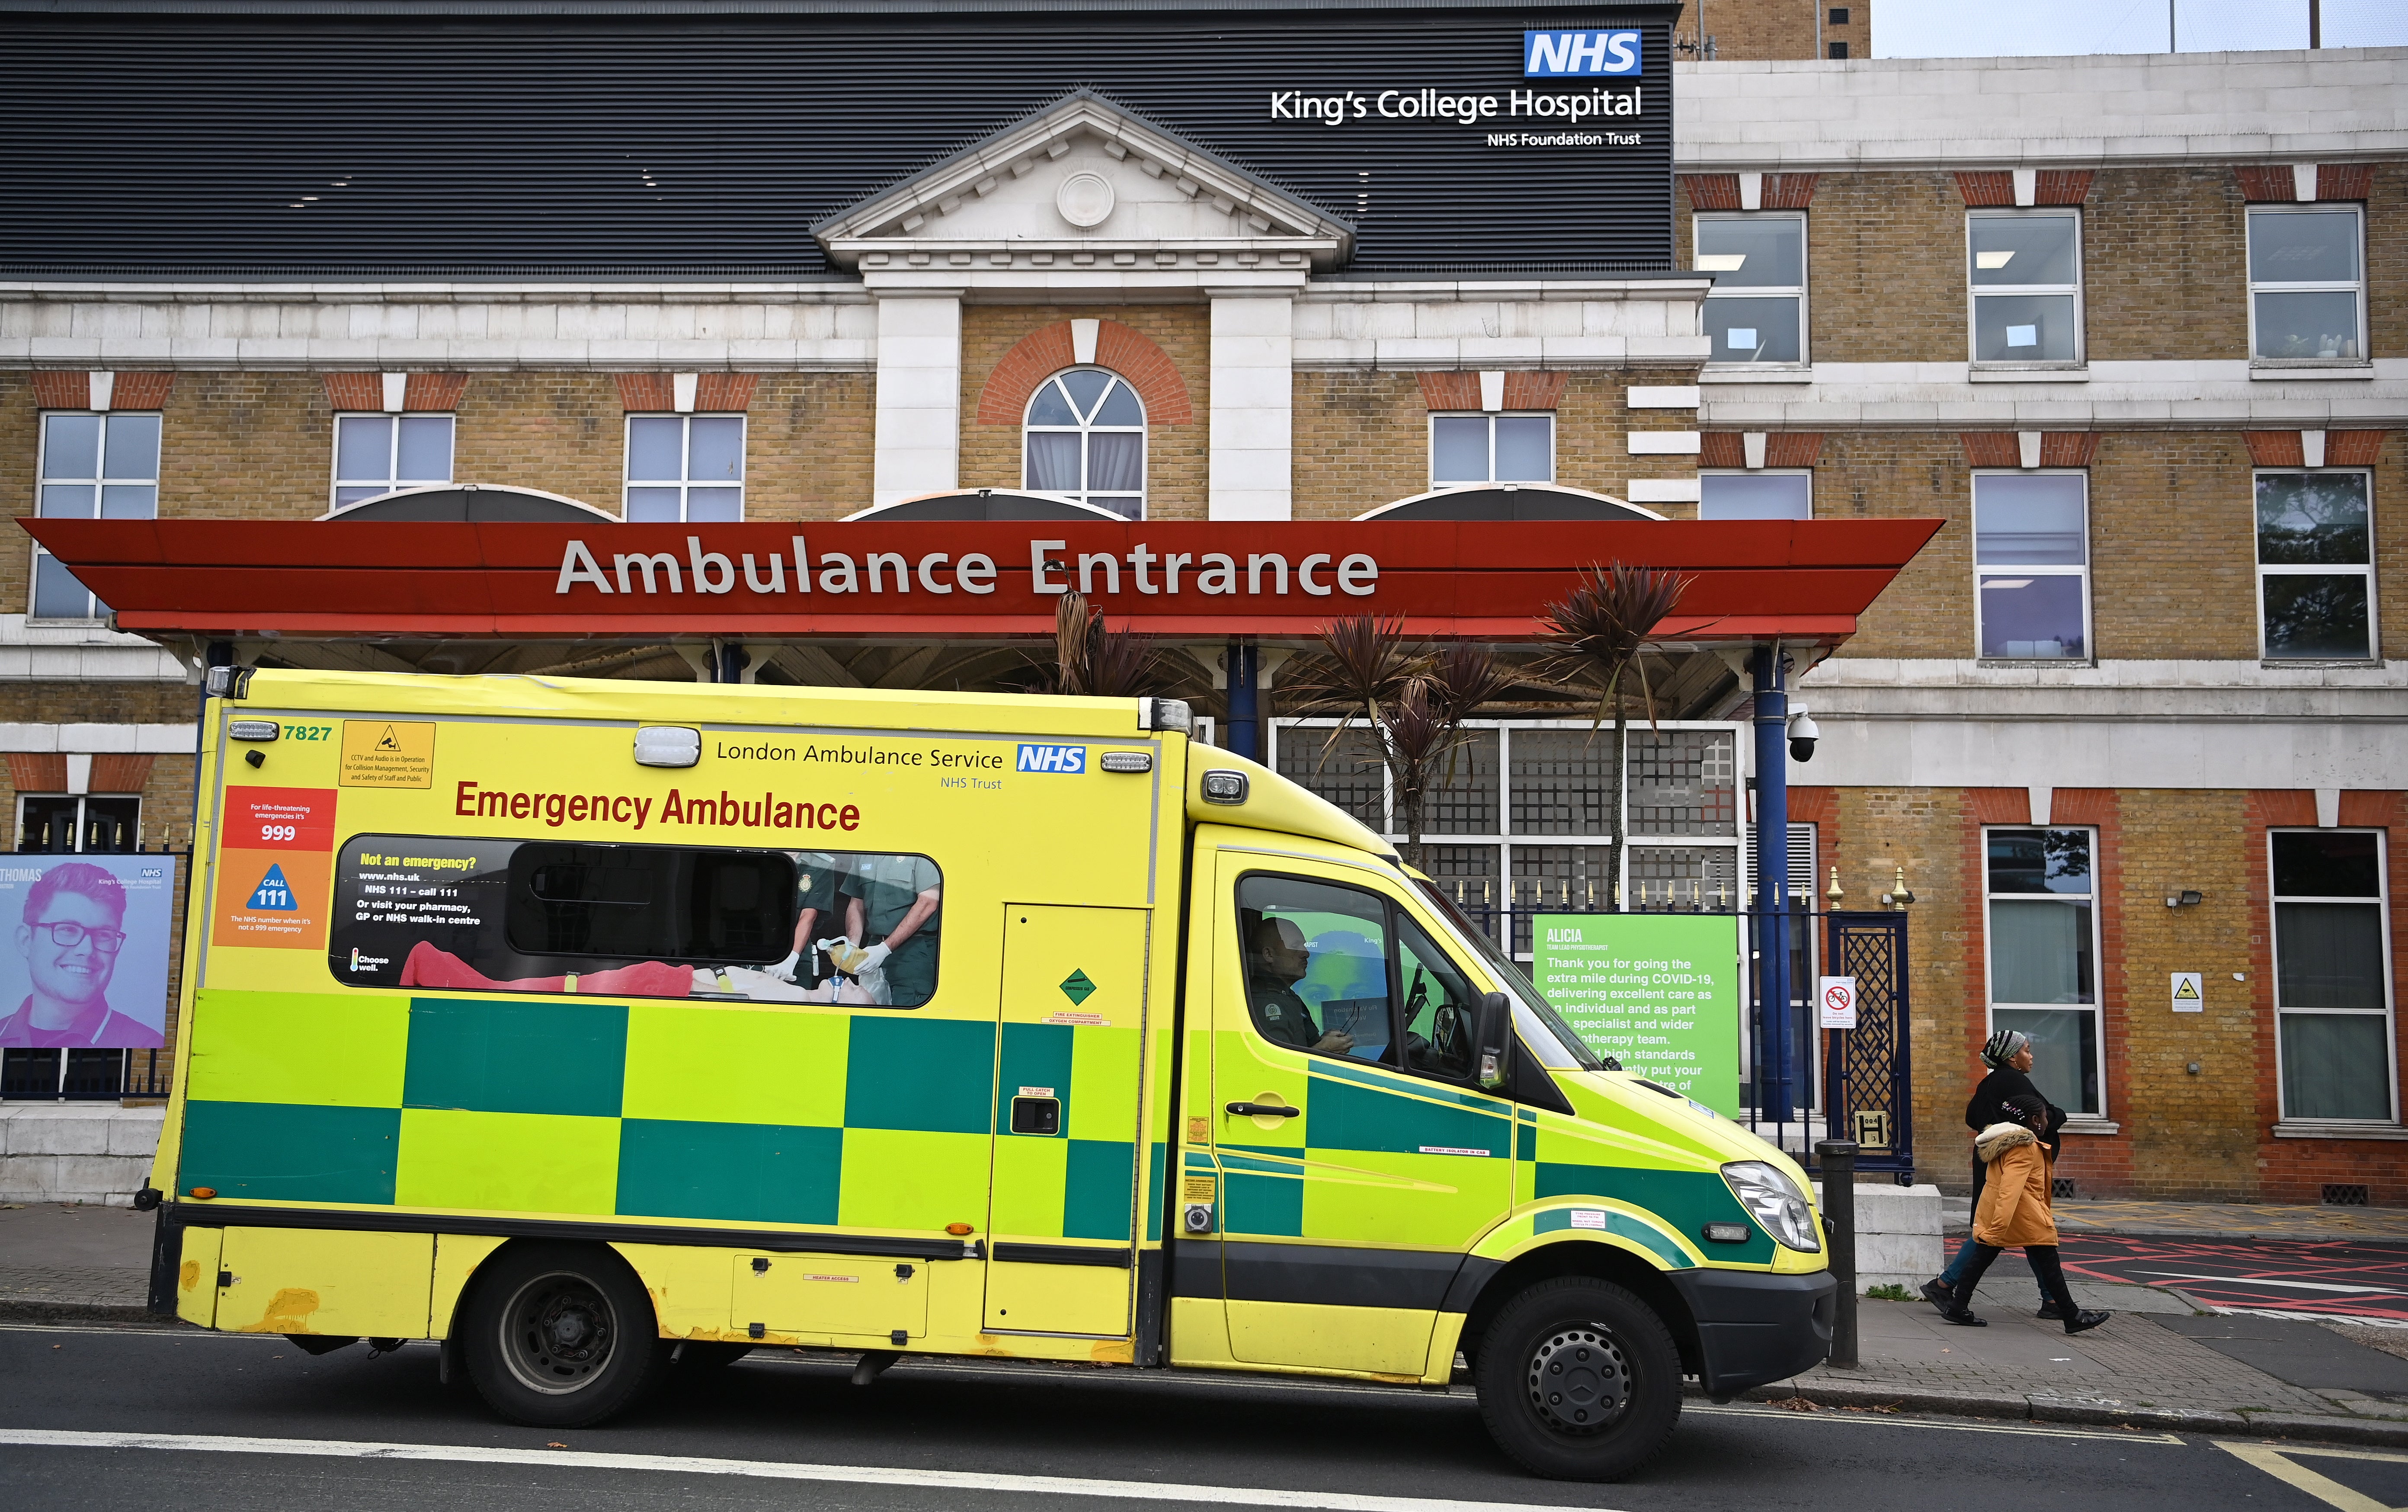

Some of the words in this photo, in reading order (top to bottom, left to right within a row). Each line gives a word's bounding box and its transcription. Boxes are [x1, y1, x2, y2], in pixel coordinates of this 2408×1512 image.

[1528, 33, 1638, 73] NHS
[1271, 91, 1366, 125] King's
[1377, 89, 1498, 124] College
[1510, 87, 1641, 122] Hospital
[1488, 134, 1517, 146] NHS
[1521, 132, 1602, 146] Foundation
[1605, 132, 1641, 145] Trust
[556, 536, 997, 594] Ambulance
[1031, 540, 1378, 596] Entrance
[284, 726, 332, 741] 7827
[717, 742, 795, 761] London
[803, 743, 922, 766] Ambulance
[930, 750, 1003, 769] Service
[1018, 746, 1084, 772] NHS
[941, 777, 967, 789] NHS
[971, 778, 1002, 790] Trust
[262, 804, 310, 813] life-threatening
[455, 781, 653, 830] Emergency
[660, 789, 860, 831] Ambulance
[262, 825, 295, 841] 999
[360, 853, 381, 865] Not
[384, 856, 399, 866] an
[403, 857, 476, 871] emergency?
[0, 868, 42, 882] THOMAS
[359, 872, 420, 881] www.nhs.uk
[257, 889, 287, 906] 111
[365, 885, 386, 894] NHS
[390, 886, 407, 895] 111
[418, 888, 436, 896] call
[440, 888, 458, 897] 111
[357, 900, 369, 908] Or
[371, 900, 392, 909] visit
[395, 902, 417, 910] your
[419, 902, 471, 913] pharmacy,
[355, 913, 370, 921] GP
[386, 913, 407, 922] NHS
[410, 915, 445, 924] walk-in
[448, 916, 480, 925] centre
[1547, 928, 1582, 942] ALICIA
[359, 955, 389, 964] Choose
[1547, 958, 1584, 968] Thank
[1588, 960, 1610, 971] you
[1613, 958, 1630, 968] for
[1633, 959, 1668, 971] going
[1672, 958, 1691, 969] the
[1547, 974, 1577, 983] extra
[1581, 973, 1606, 983] mile
[1609, 973, 1648, 986] during
[1652, 974, 1714, 986] COVID-19,
[1547, 988, 1606, 1000] delivering
[1610, 989, 1665, 999] excellent
[1668, 991, 1694, 1000] care
[1697, 991, 1712, 1000] as
[1566, 1003, 1624, 1013] individual
[1628, 1004, 1650, 1014] and
[1654, 1006, 1668, 1014] as
[1672, 1005, 1696, 1016] part
[1573, 1019, 1630, 1031] specialist
[1634, 1019, 1656, 1029] and
[1660, 1019, 1694, 1029] wider
[1637, 1034, 1671, 1044] team.
[1604, 1049, 1630, 1061] high
[1635, 1049, 1695, 1060] standards
[1651, 1065, 1671, 1076] put
[1674, 1067, 1702, 1077] your
[1679, 1080, 1691, 1090] of
